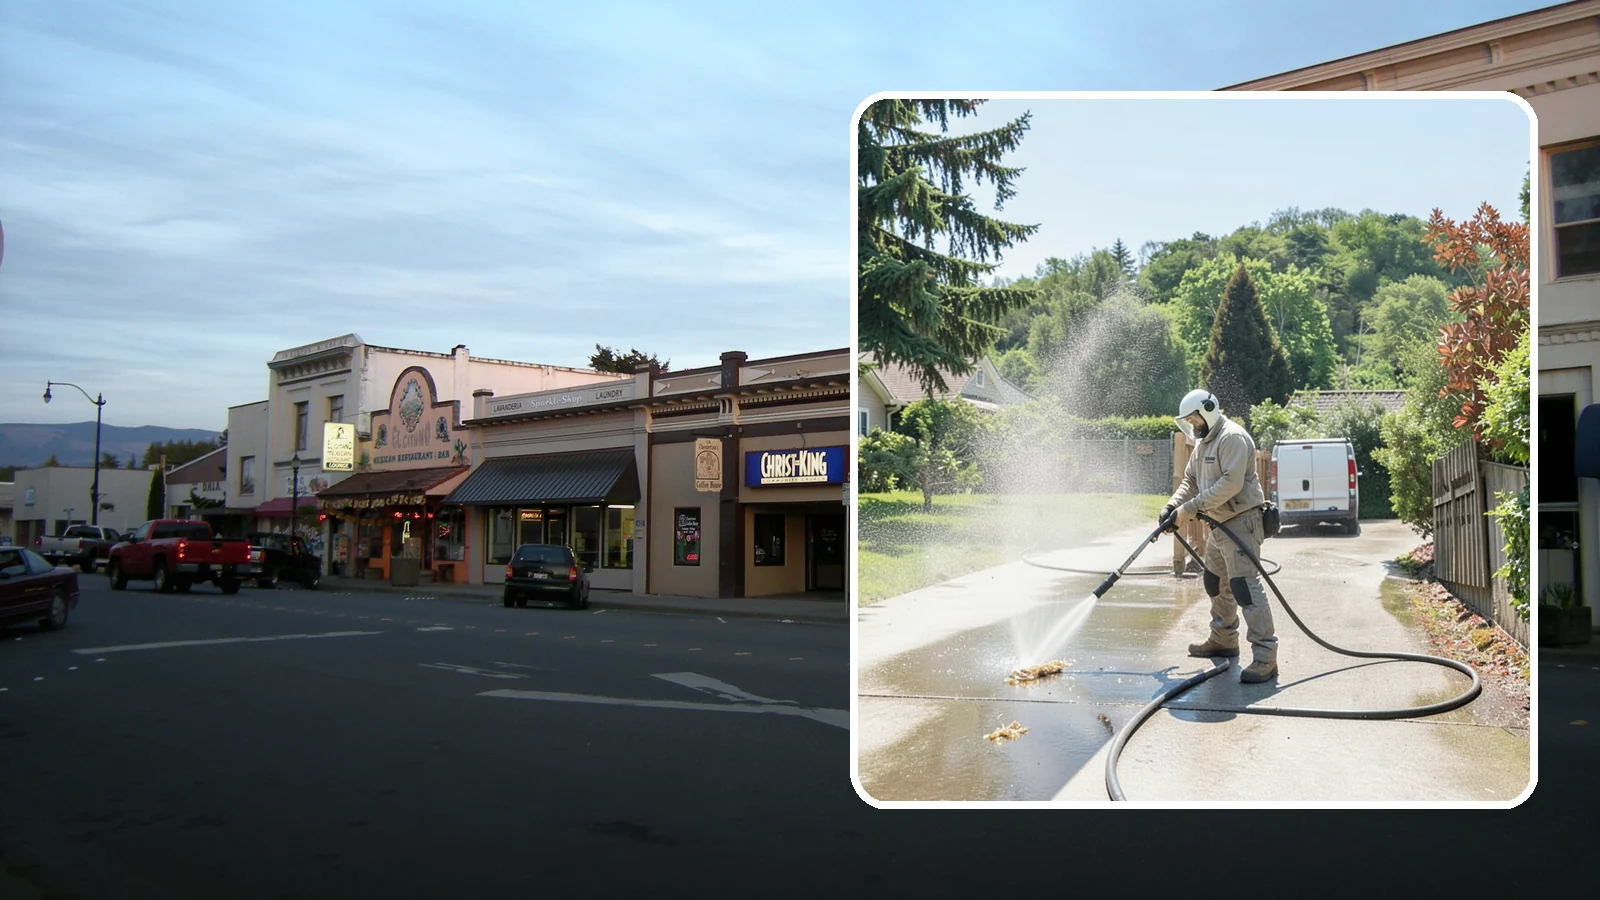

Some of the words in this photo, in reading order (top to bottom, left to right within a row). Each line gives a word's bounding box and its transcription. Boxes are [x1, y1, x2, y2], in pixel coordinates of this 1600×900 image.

[595, 389, 624, 400] LAUNDRY
[530, 398, 560, 409] Sparkle
[562, 393, 583, 405] Shop
[493, 402, 523, 413] LAVANDERIA
[373, 455, 396, 464] MEXICAN
[397, 451, 434, 462] RESTAURANT
[438, 450, 450, 459] BAR
[696, 480, 710, 489] Coffee
